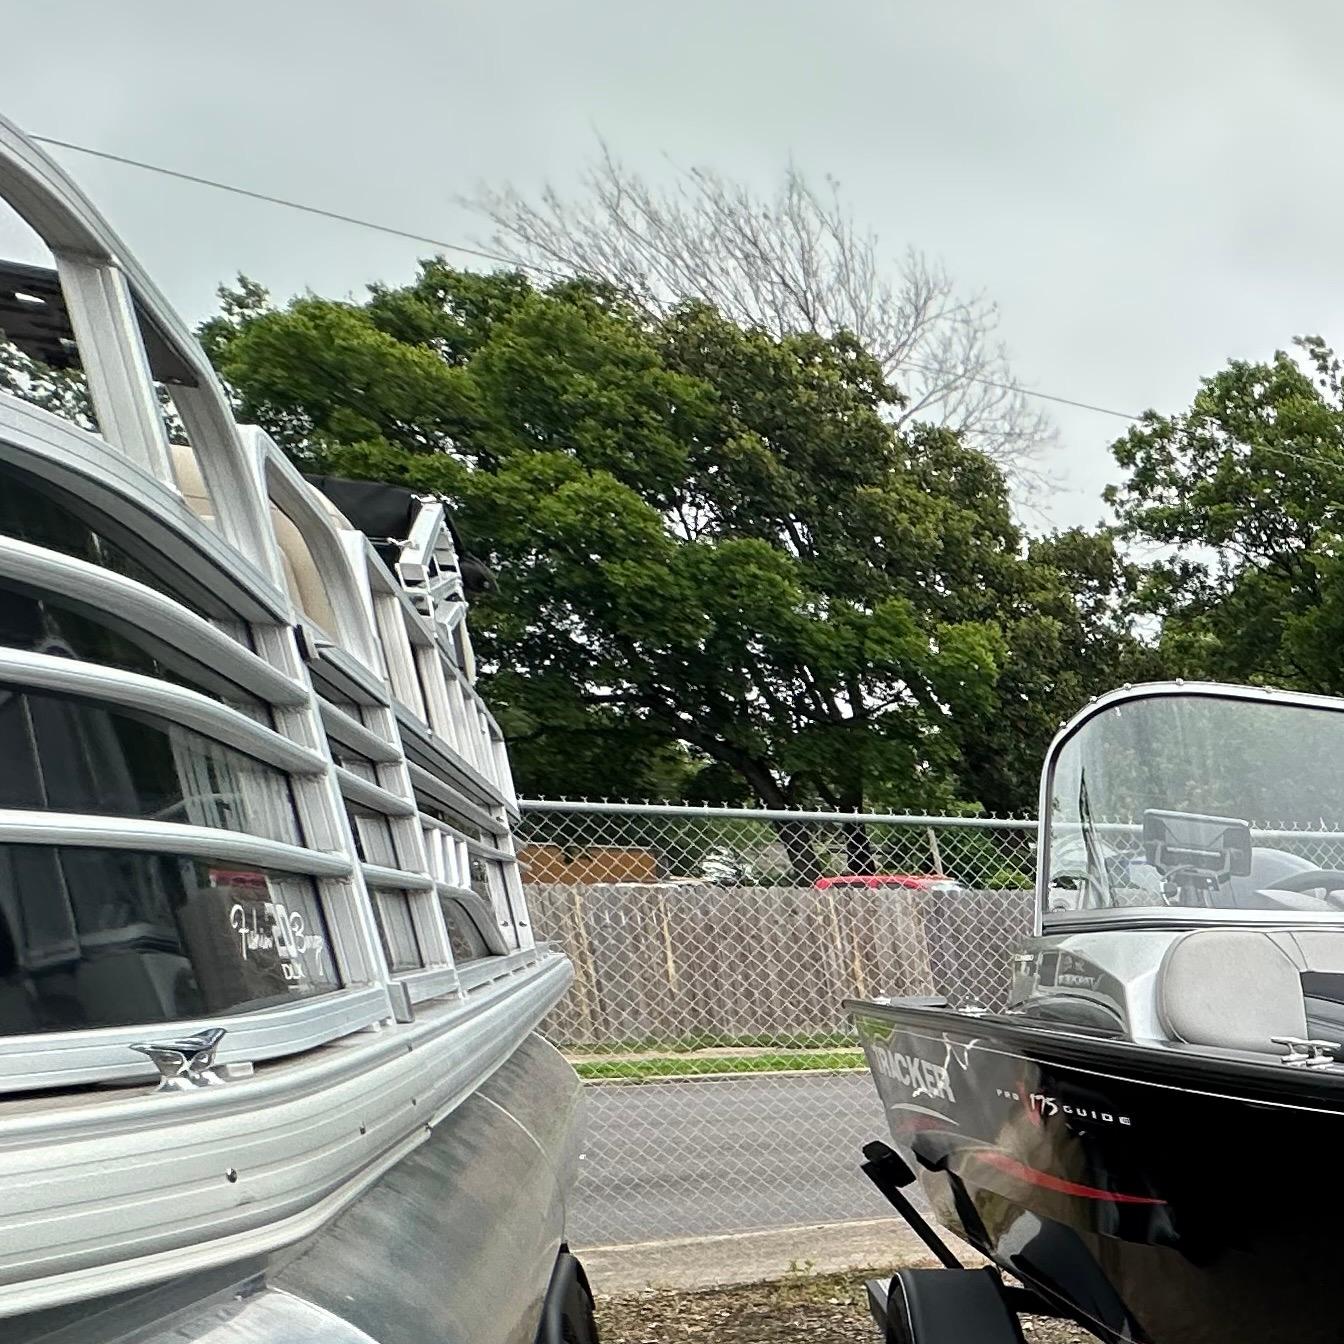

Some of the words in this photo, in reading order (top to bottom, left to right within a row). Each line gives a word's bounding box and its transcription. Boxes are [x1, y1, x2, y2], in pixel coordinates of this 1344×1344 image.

[996, 1088, 1020, 1101] PRO
[1029, 1093, 1059, 1116] 175
[1062, 1105, 1132, 1126] GUIDE
